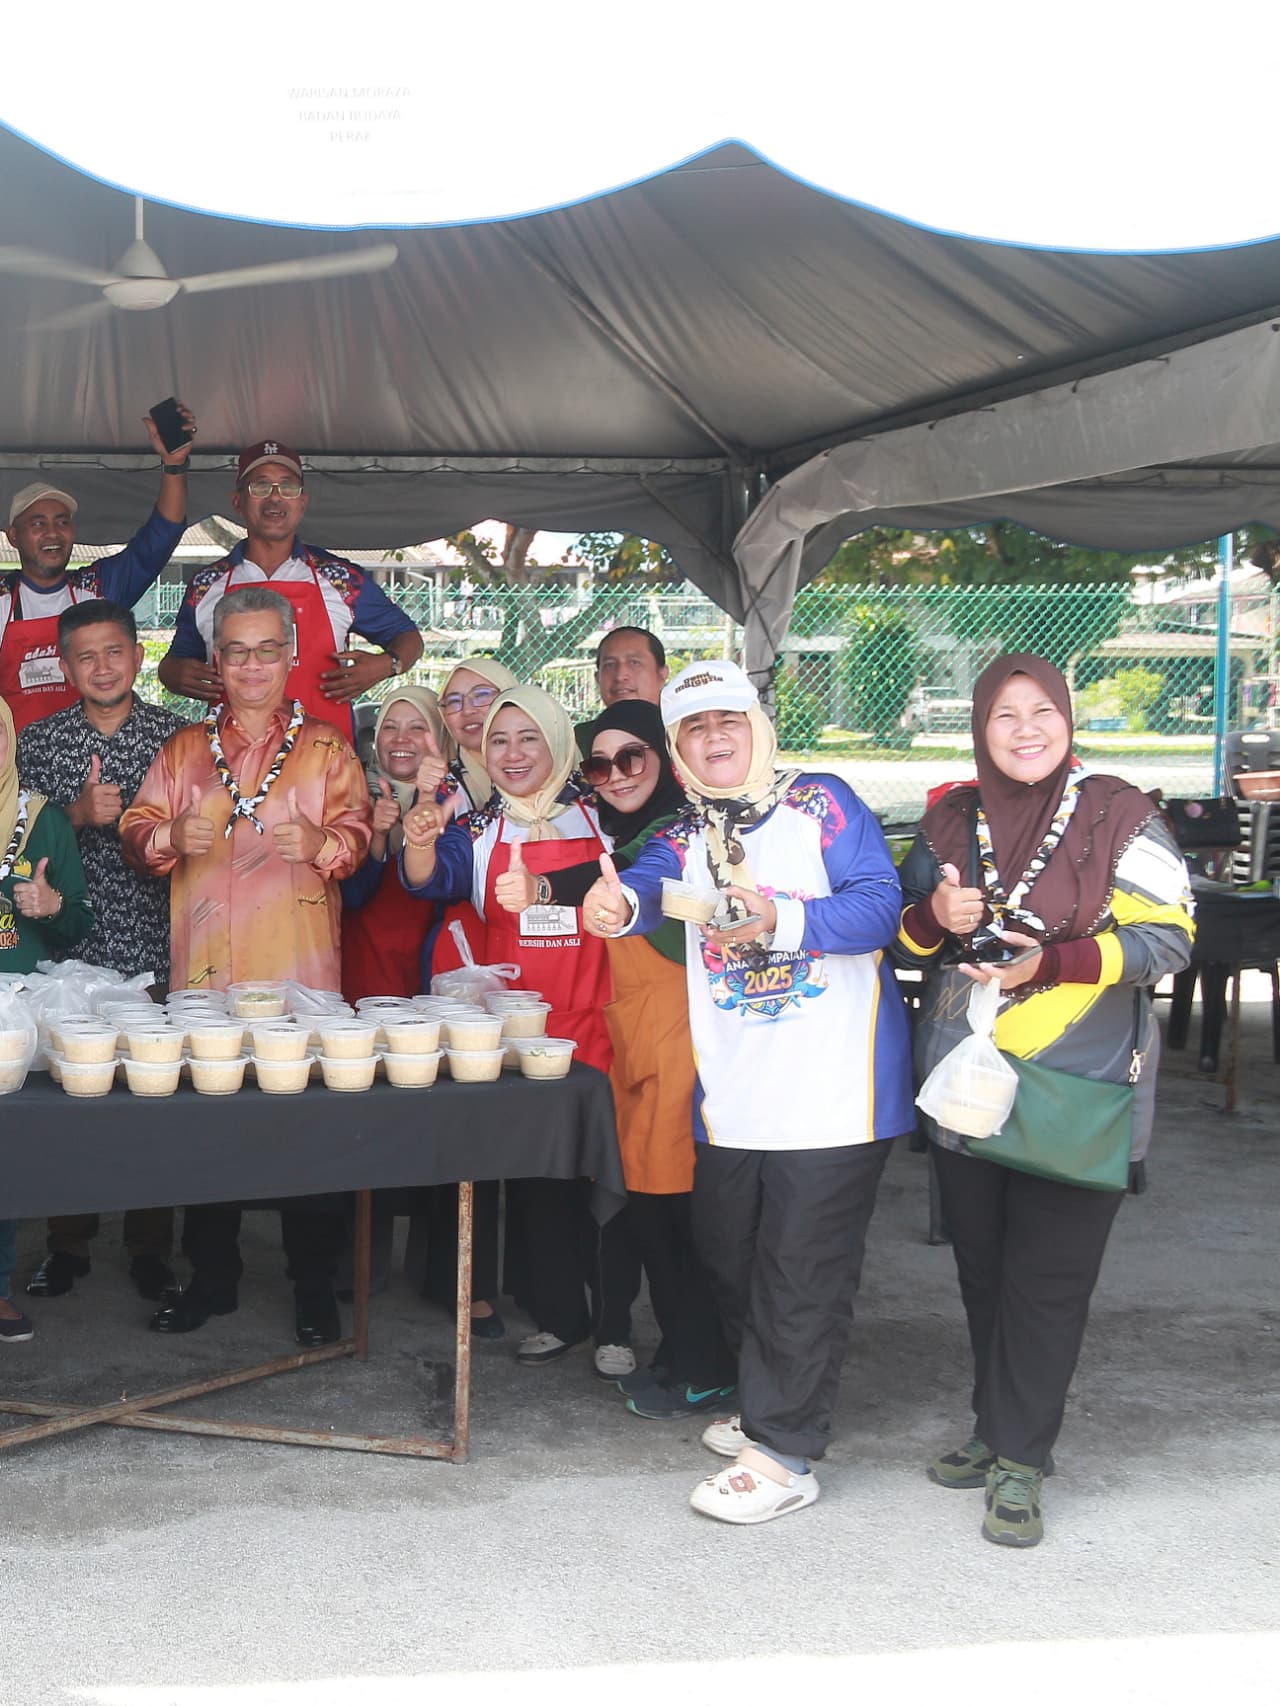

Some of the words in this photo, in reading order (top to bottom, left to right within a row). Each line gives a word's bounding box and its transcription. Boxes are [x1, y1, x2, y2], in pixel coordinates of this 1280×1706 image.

[287, 87, 348, 99] WARISAN
[298, 110, 345, 121] BADAN
[329, 130, 371, 143] PERAK
[25, 645, 56, 661] adabi
[545, 940, 562, 948] DAN
[563, 938, 581, 947] ASLI
[726, 961, 750, 973] ANA
[744, 964, 793, 995] 2025
